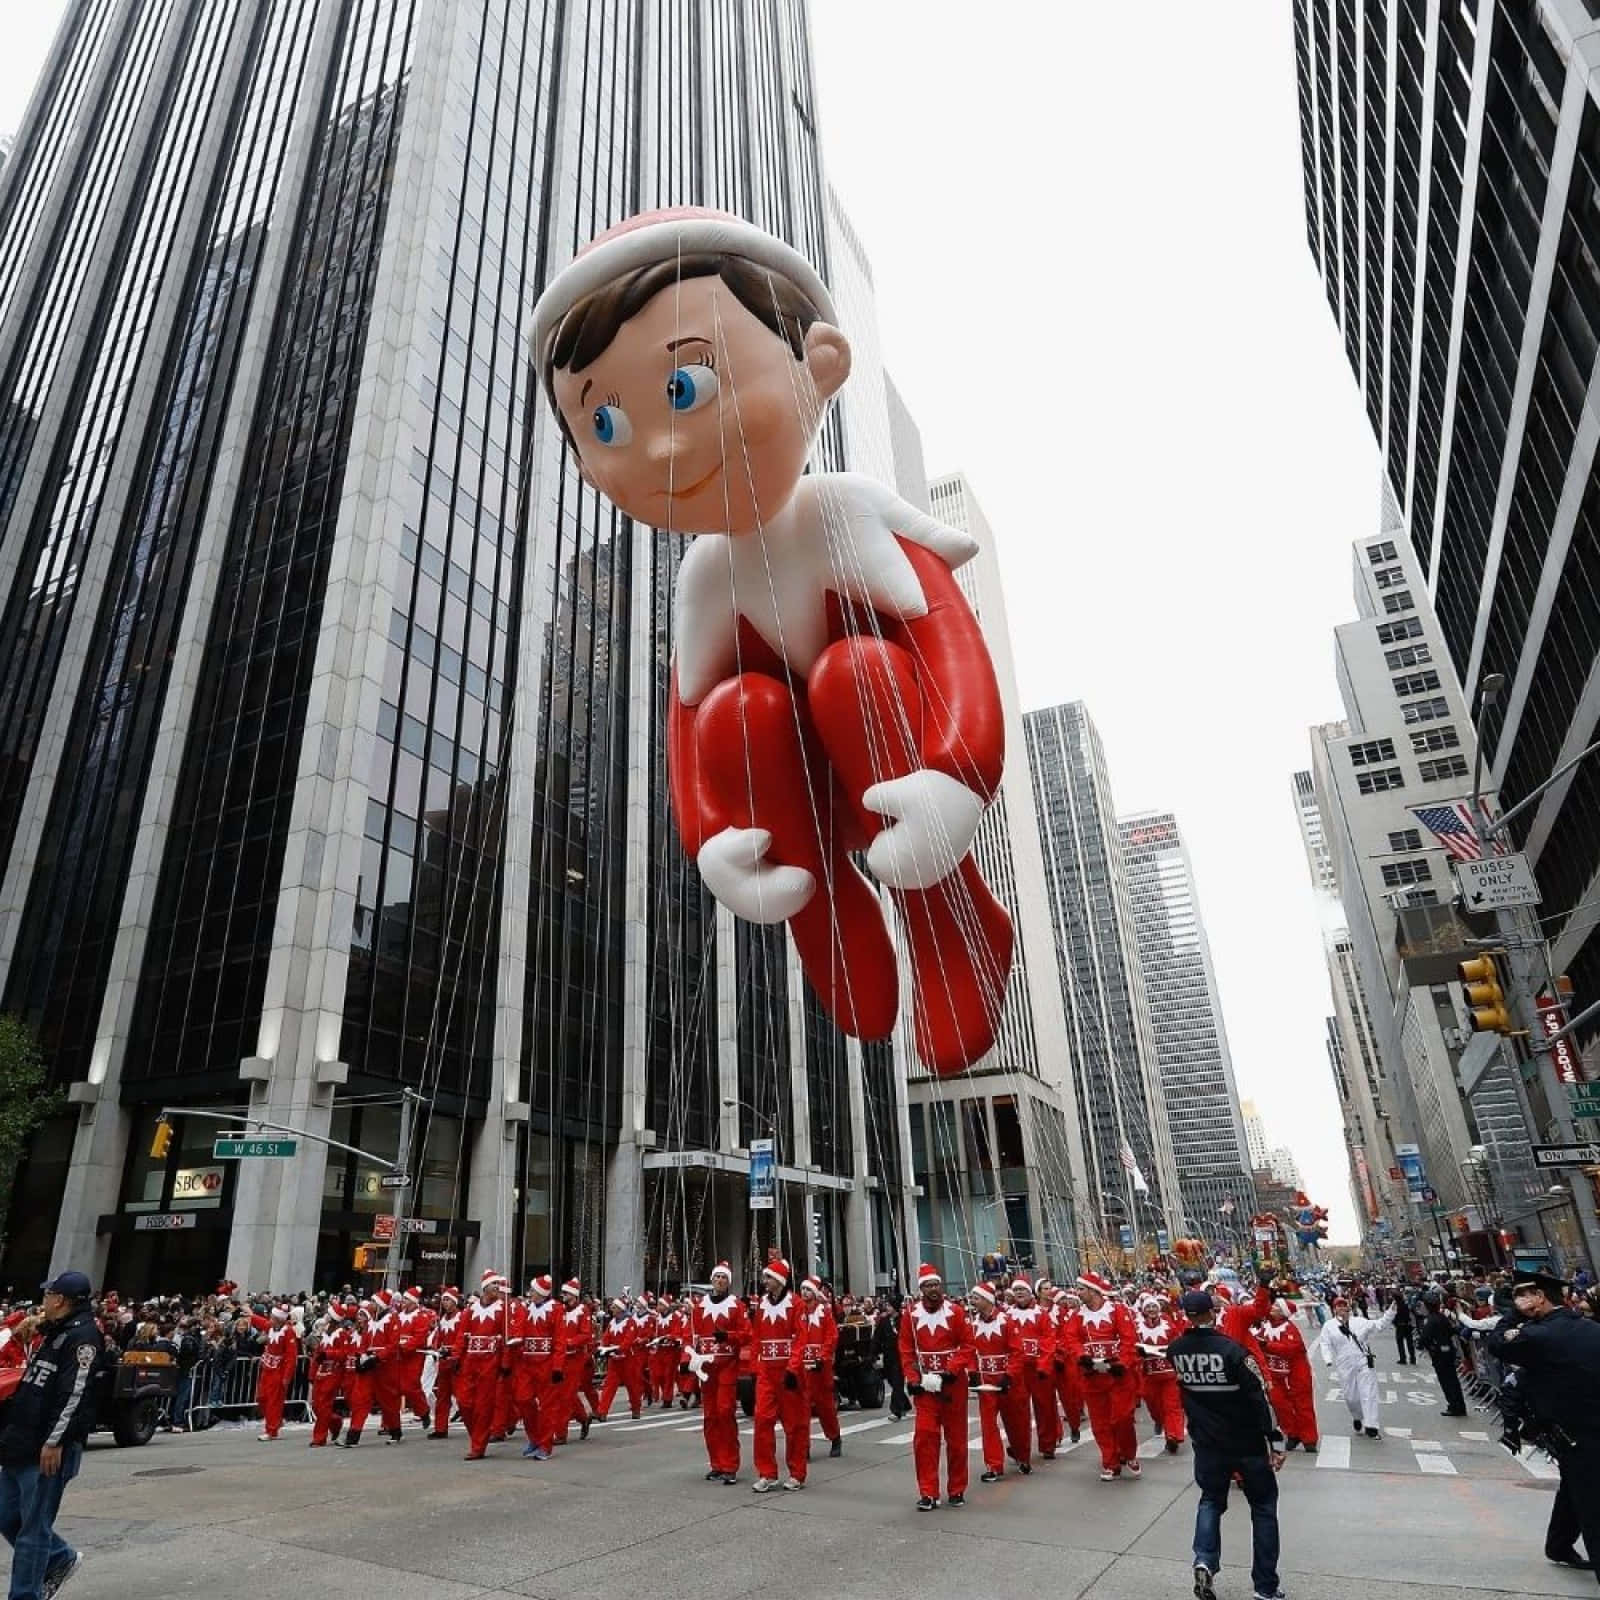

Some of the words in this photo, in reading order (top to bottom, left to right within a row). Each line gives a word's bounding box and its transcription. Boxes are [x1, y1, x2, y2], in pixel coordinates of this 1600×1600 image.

[1470, 860, 1515, 875] BUSES
[1479, 873, 1512, 887] ONLY
[1545, 1013, 1577, 1083] McDonld's
[234, 1143, 244, 1154] W
[249, 1143, 264, 1154] 46
[1543, 1151, 1567, 1161] ON
[175, 1174, 202, 1193] SBC
[335, 1172, 377, 1193] HBC
[1173, 1353, 1224, 1373] NYPD
